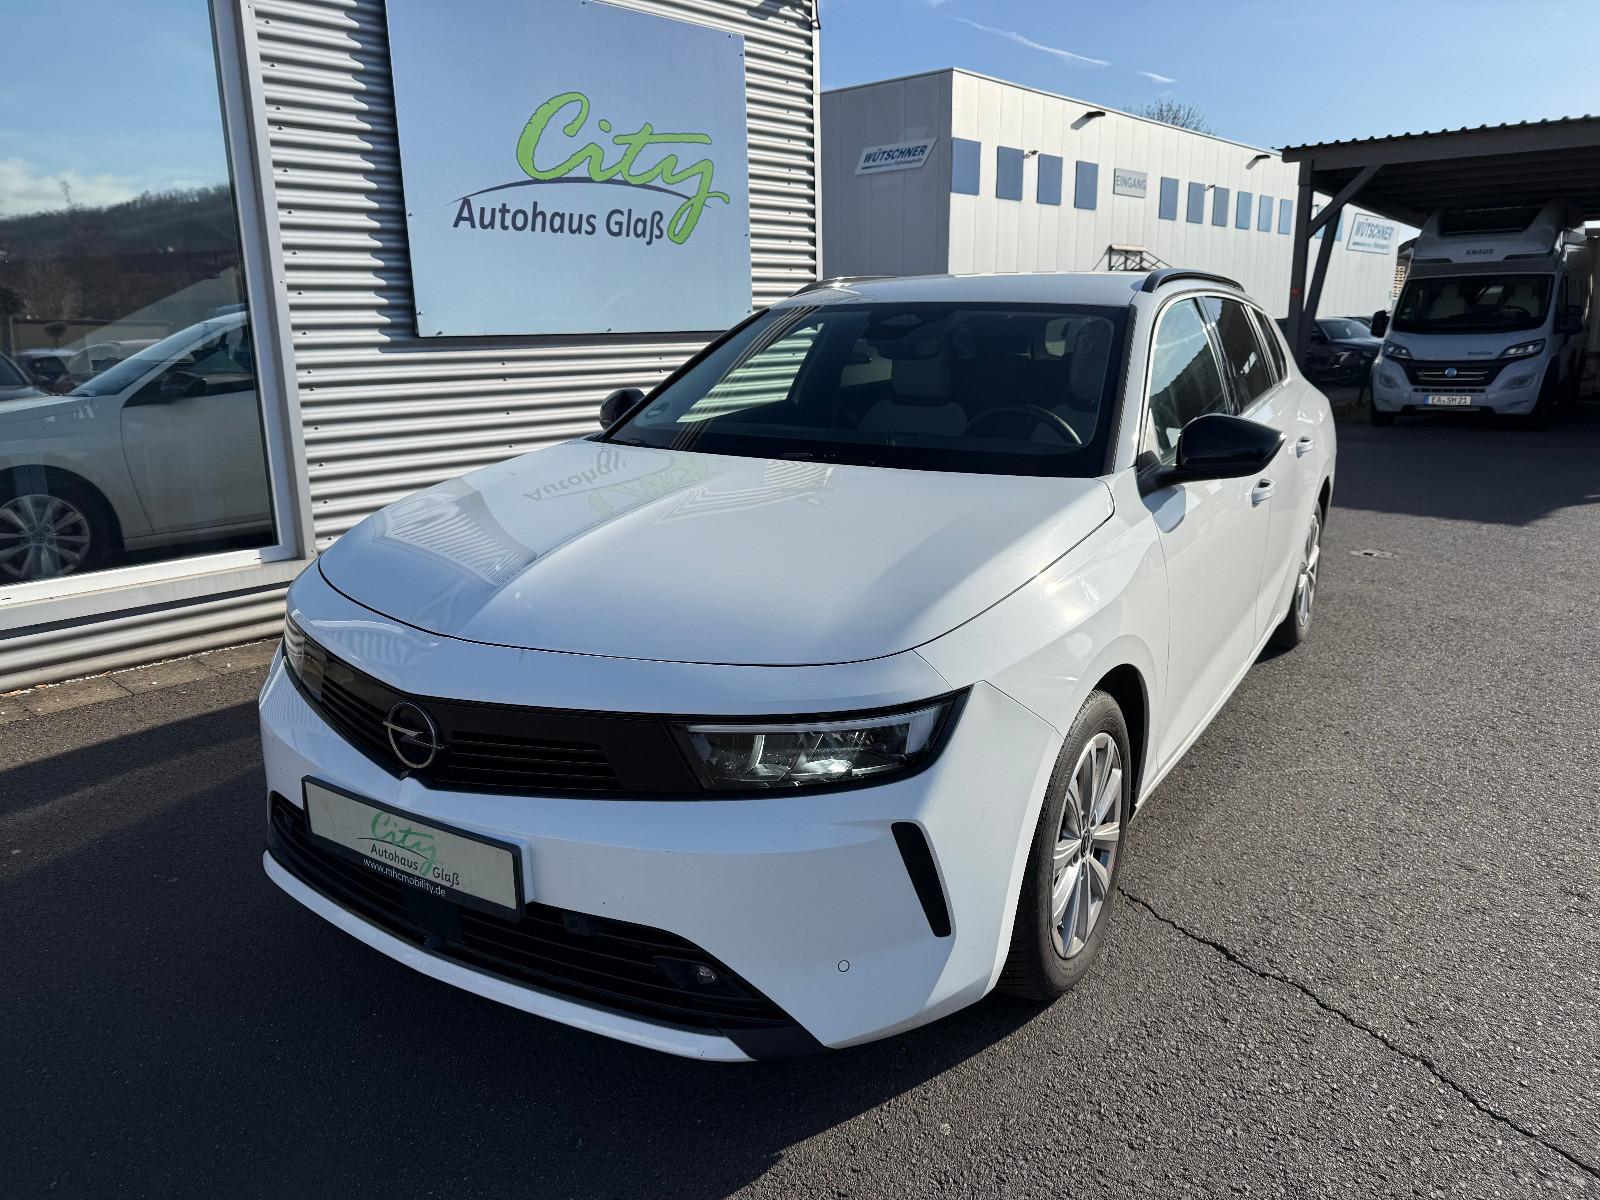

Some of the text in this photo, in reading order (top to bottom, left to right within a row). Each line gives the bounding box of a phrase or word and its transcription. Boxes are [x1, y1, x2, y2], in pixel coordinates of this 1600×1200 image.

[516, 91, 730, 244] City
[863, 144, 928, 164] WÜTSCHNER
[1115, 174, 1147, 191] EINGANG
[453, 197, 665, 246] Autohaus Glaß
[1465, 248, 1494, 256] KNAUS
[371, 812, 437, 876] City
[363, 859, 446, 896] www.mhcmobility.de
[371, 844, 460, 888] Autohaus Glaß
